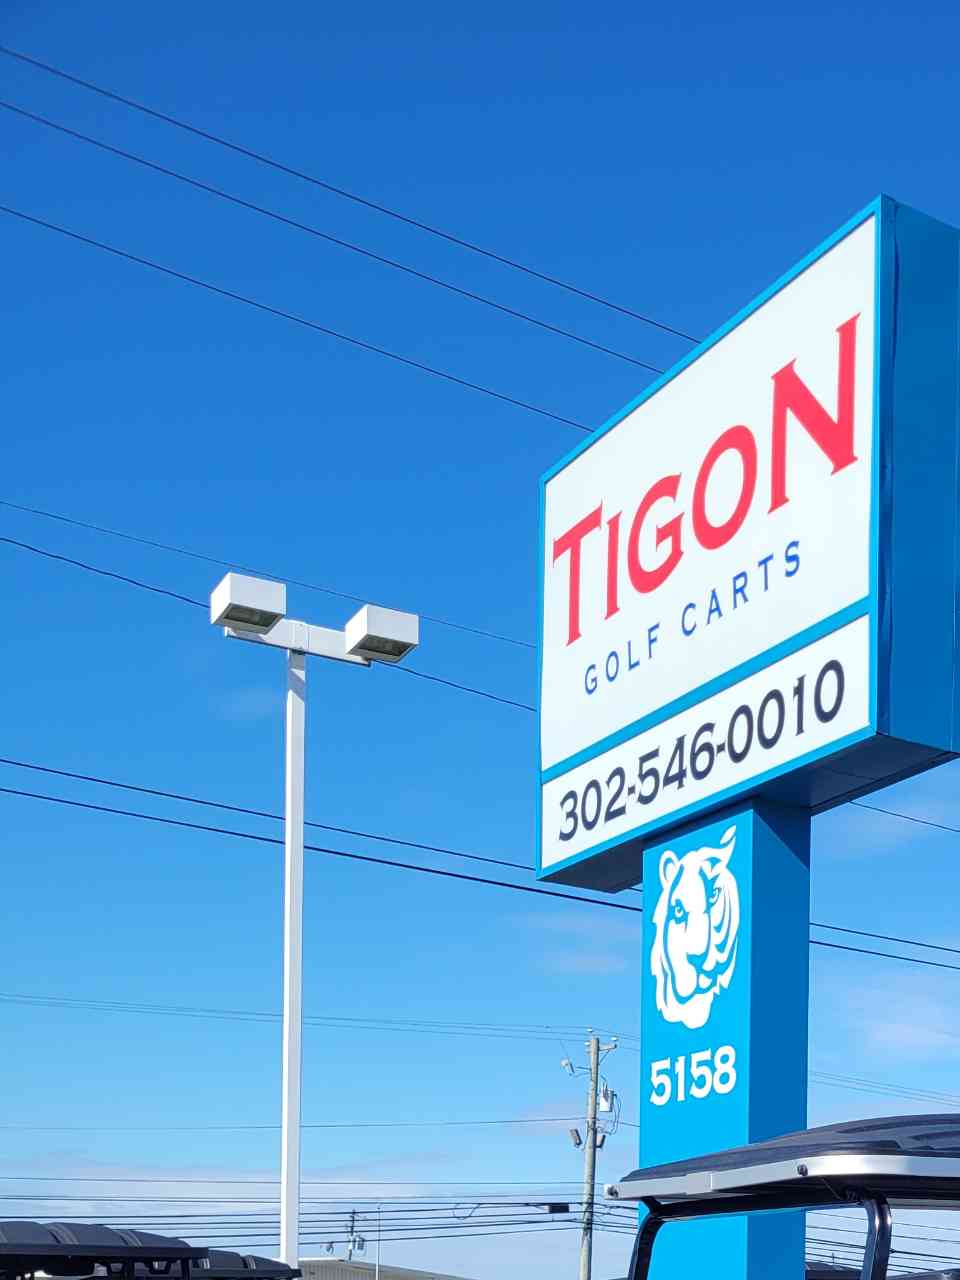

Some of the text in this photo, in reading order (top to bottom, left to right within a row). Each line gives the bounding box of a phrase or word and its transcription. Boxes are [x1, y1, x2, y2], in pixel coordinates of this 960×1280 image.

[553, 311, 861, 646] TIGON
[584, 540, 800, 695] GOLF CARTS
[558, 659, 845, 841] 302-546-0010
[650, 1045, 737, 1106] 5158
